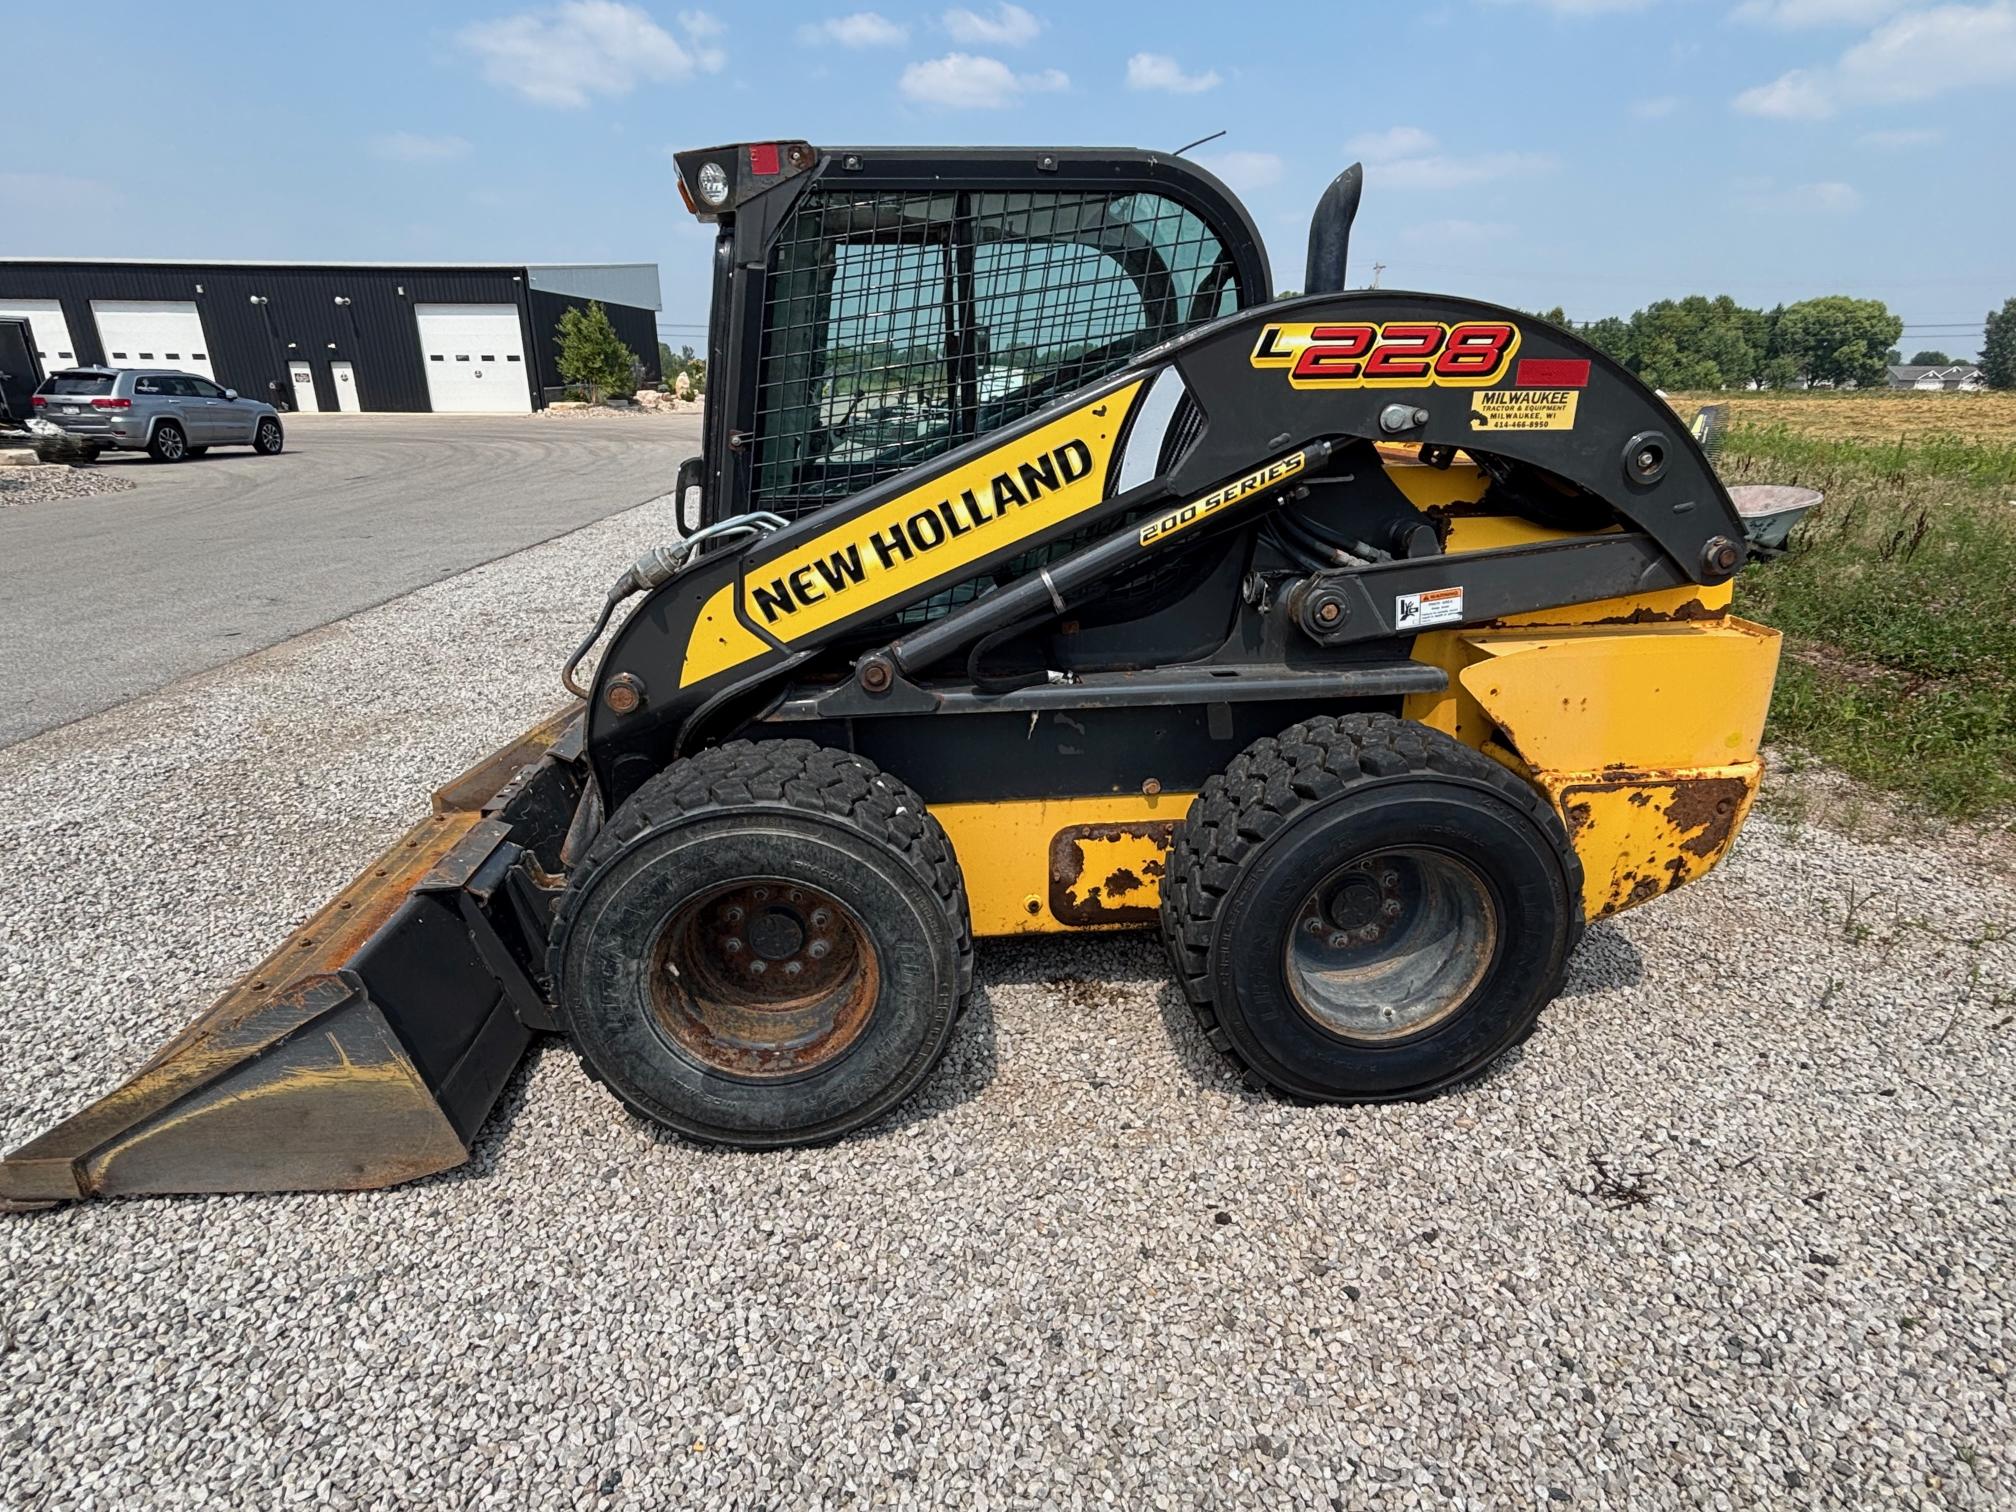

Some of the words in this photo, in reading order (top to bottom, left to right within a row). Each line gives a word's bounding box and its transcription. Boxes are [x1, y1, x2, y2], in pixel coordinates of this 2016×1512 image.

[1253, 325, 1516, 381] L228
[1481, 391, 1570, 405] MILWAUKEE
[1490, 412, 1542, 420] MILWAUKEE,
[1143, 505, 1196, 542] 200
[1205, 454, 1302, 512] SERIES
[752, 543, 868, 624] NEW
[869, 438, 1094, 570] HOLLAND
